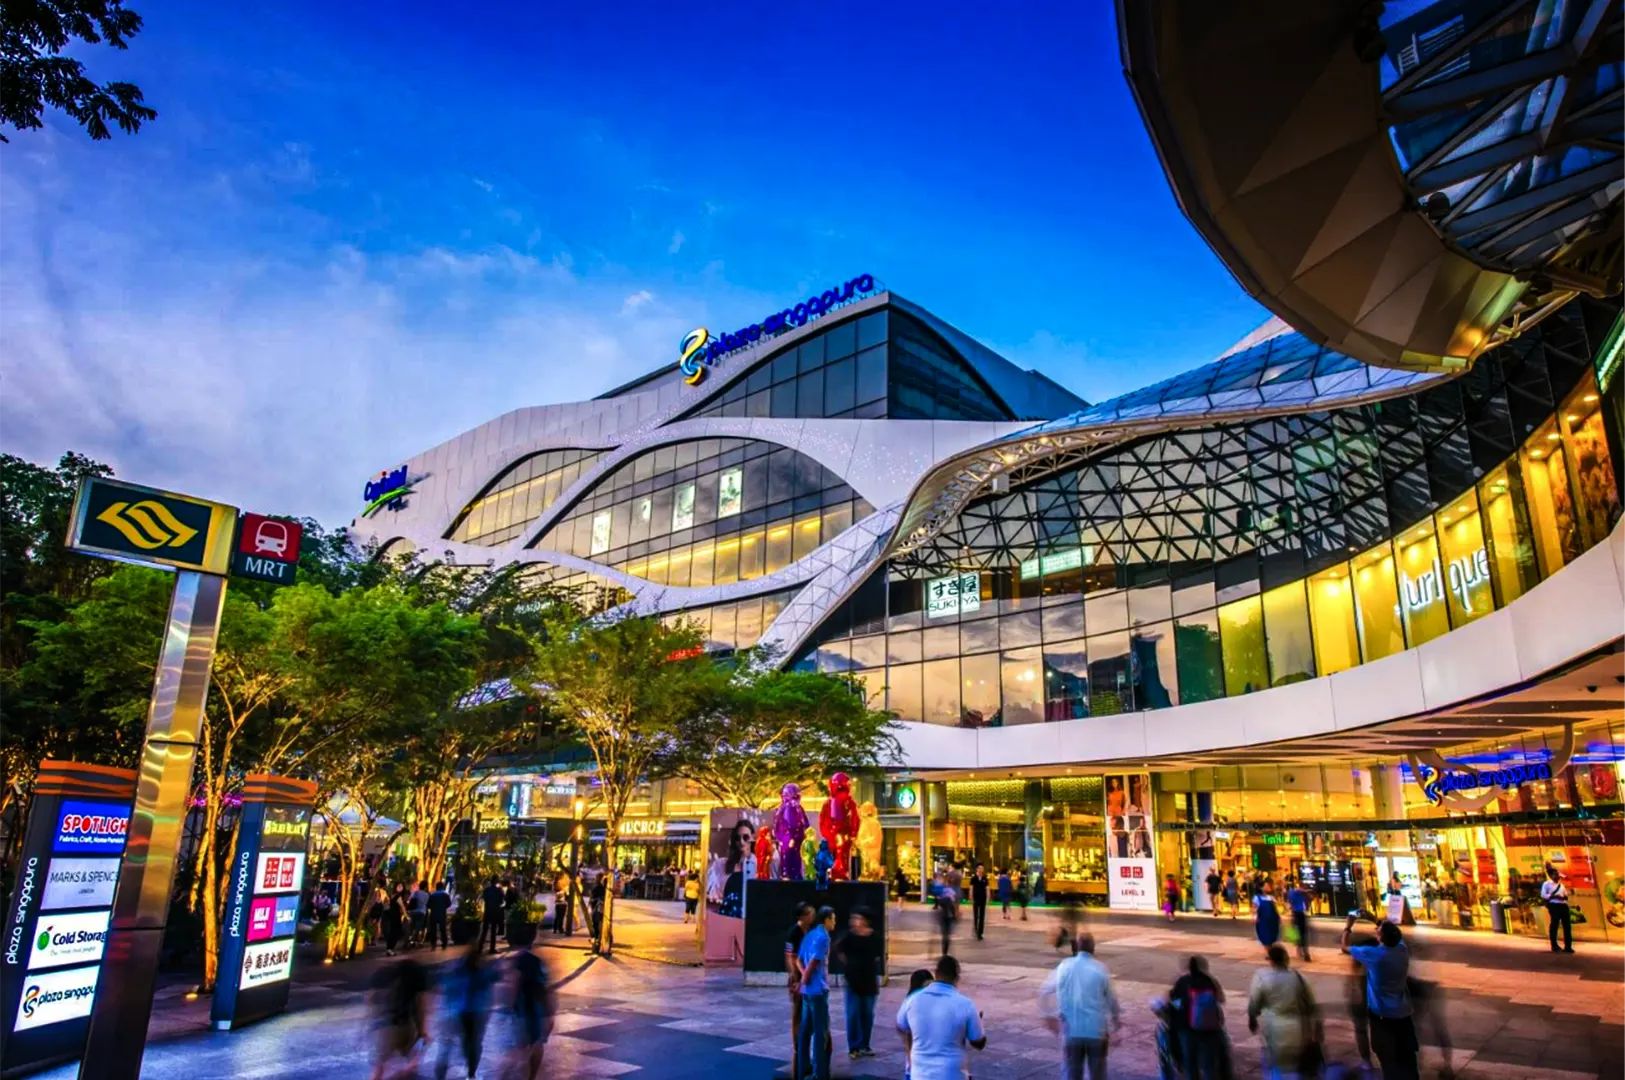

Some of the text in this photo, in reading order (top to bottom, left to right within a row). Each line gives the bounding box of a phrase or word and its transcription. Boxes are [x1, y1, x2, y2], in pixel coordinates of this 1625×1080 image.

[706, 273, 874, 366] plaza singapura
[245, 557, 288, 579] MRT
[1394, 548, 1490, 617] Jurlque
[932, 575, 977, 600] すき屋
[1441, 763, 1553, 796] plaza singapura
[50, 870, 118, 883] MARKS & SPENC
[229, 851, 250, 938] plaza singapura
[5, 857, 39, 965] plaza singapura
[52, 931, 76, 946] Cold
[37, 990, 63, 1007] plaza
